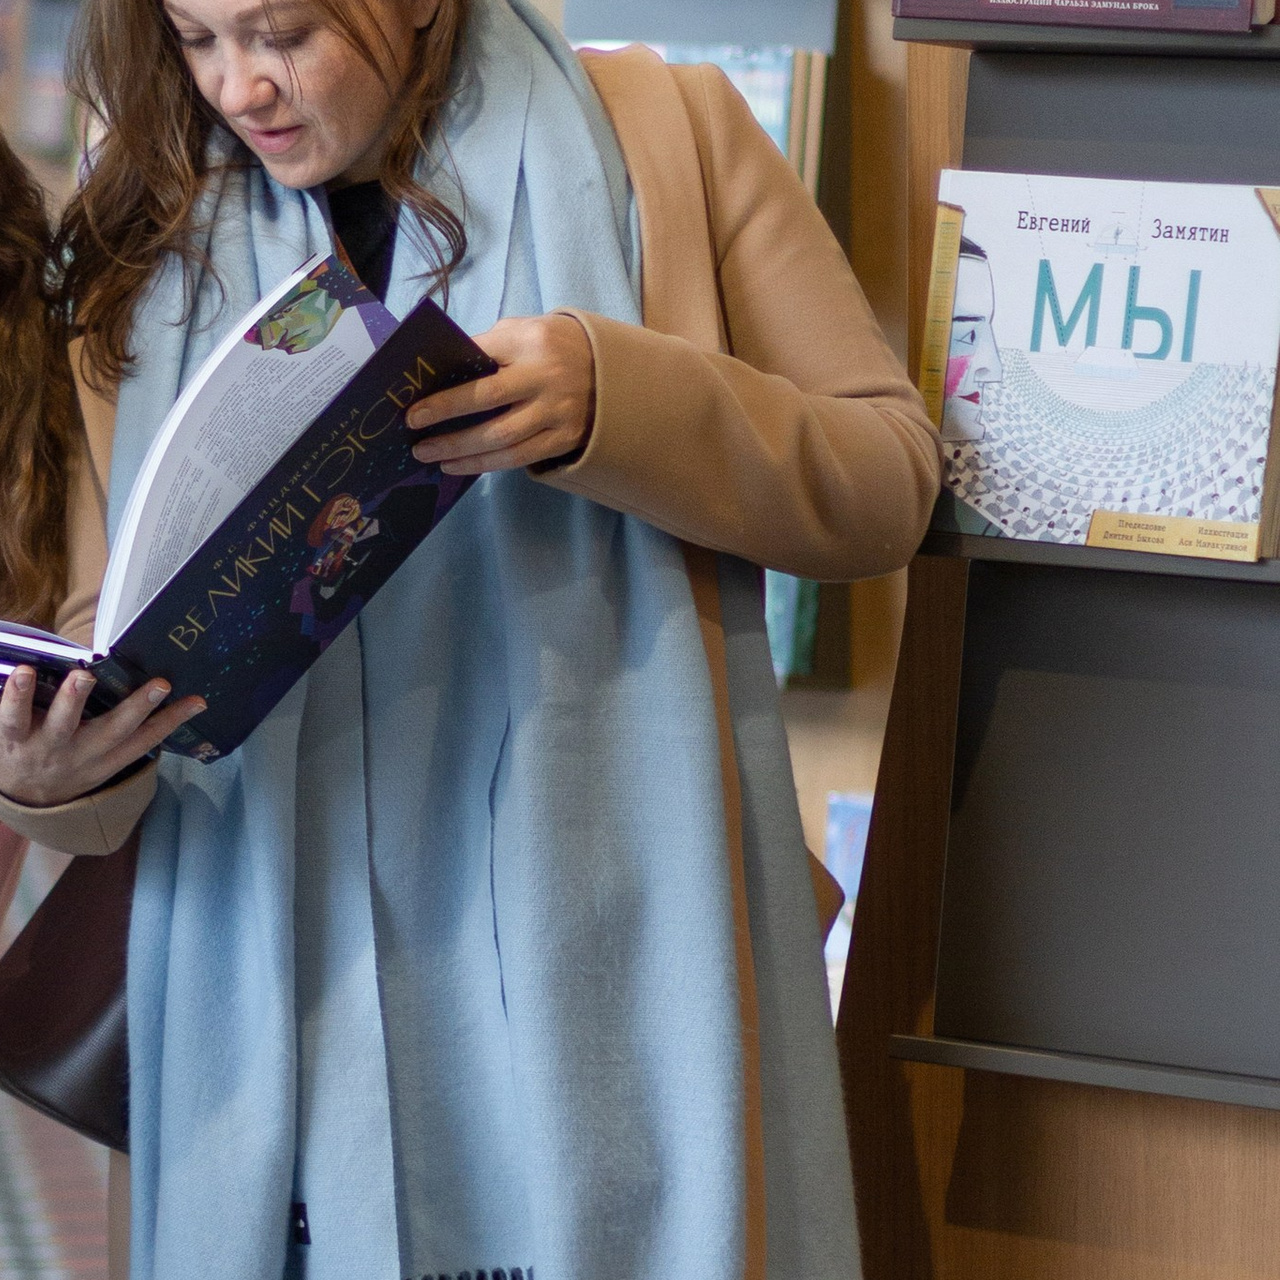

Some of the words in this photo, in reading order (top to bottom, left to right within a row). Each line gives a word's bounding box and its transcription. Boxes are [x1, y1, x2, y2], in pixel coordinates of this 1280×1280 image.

[1091, 0, 1131, 10] ЭДМУНДА
[1132, 1, 1160, 11] БРОКА
[1016, 210, 1091, 234] Евгений
[1151, 218, 1230, 244] Замятин
[1029, 258, 1202, 363] МЫ
[168, 502, 306, 652] ВЕЛИКИЙ
[302, 356, 436, 503] ГЭТСБИ
[247, 407, 360, 532] ФИЦДЖЕРАЛЬД
